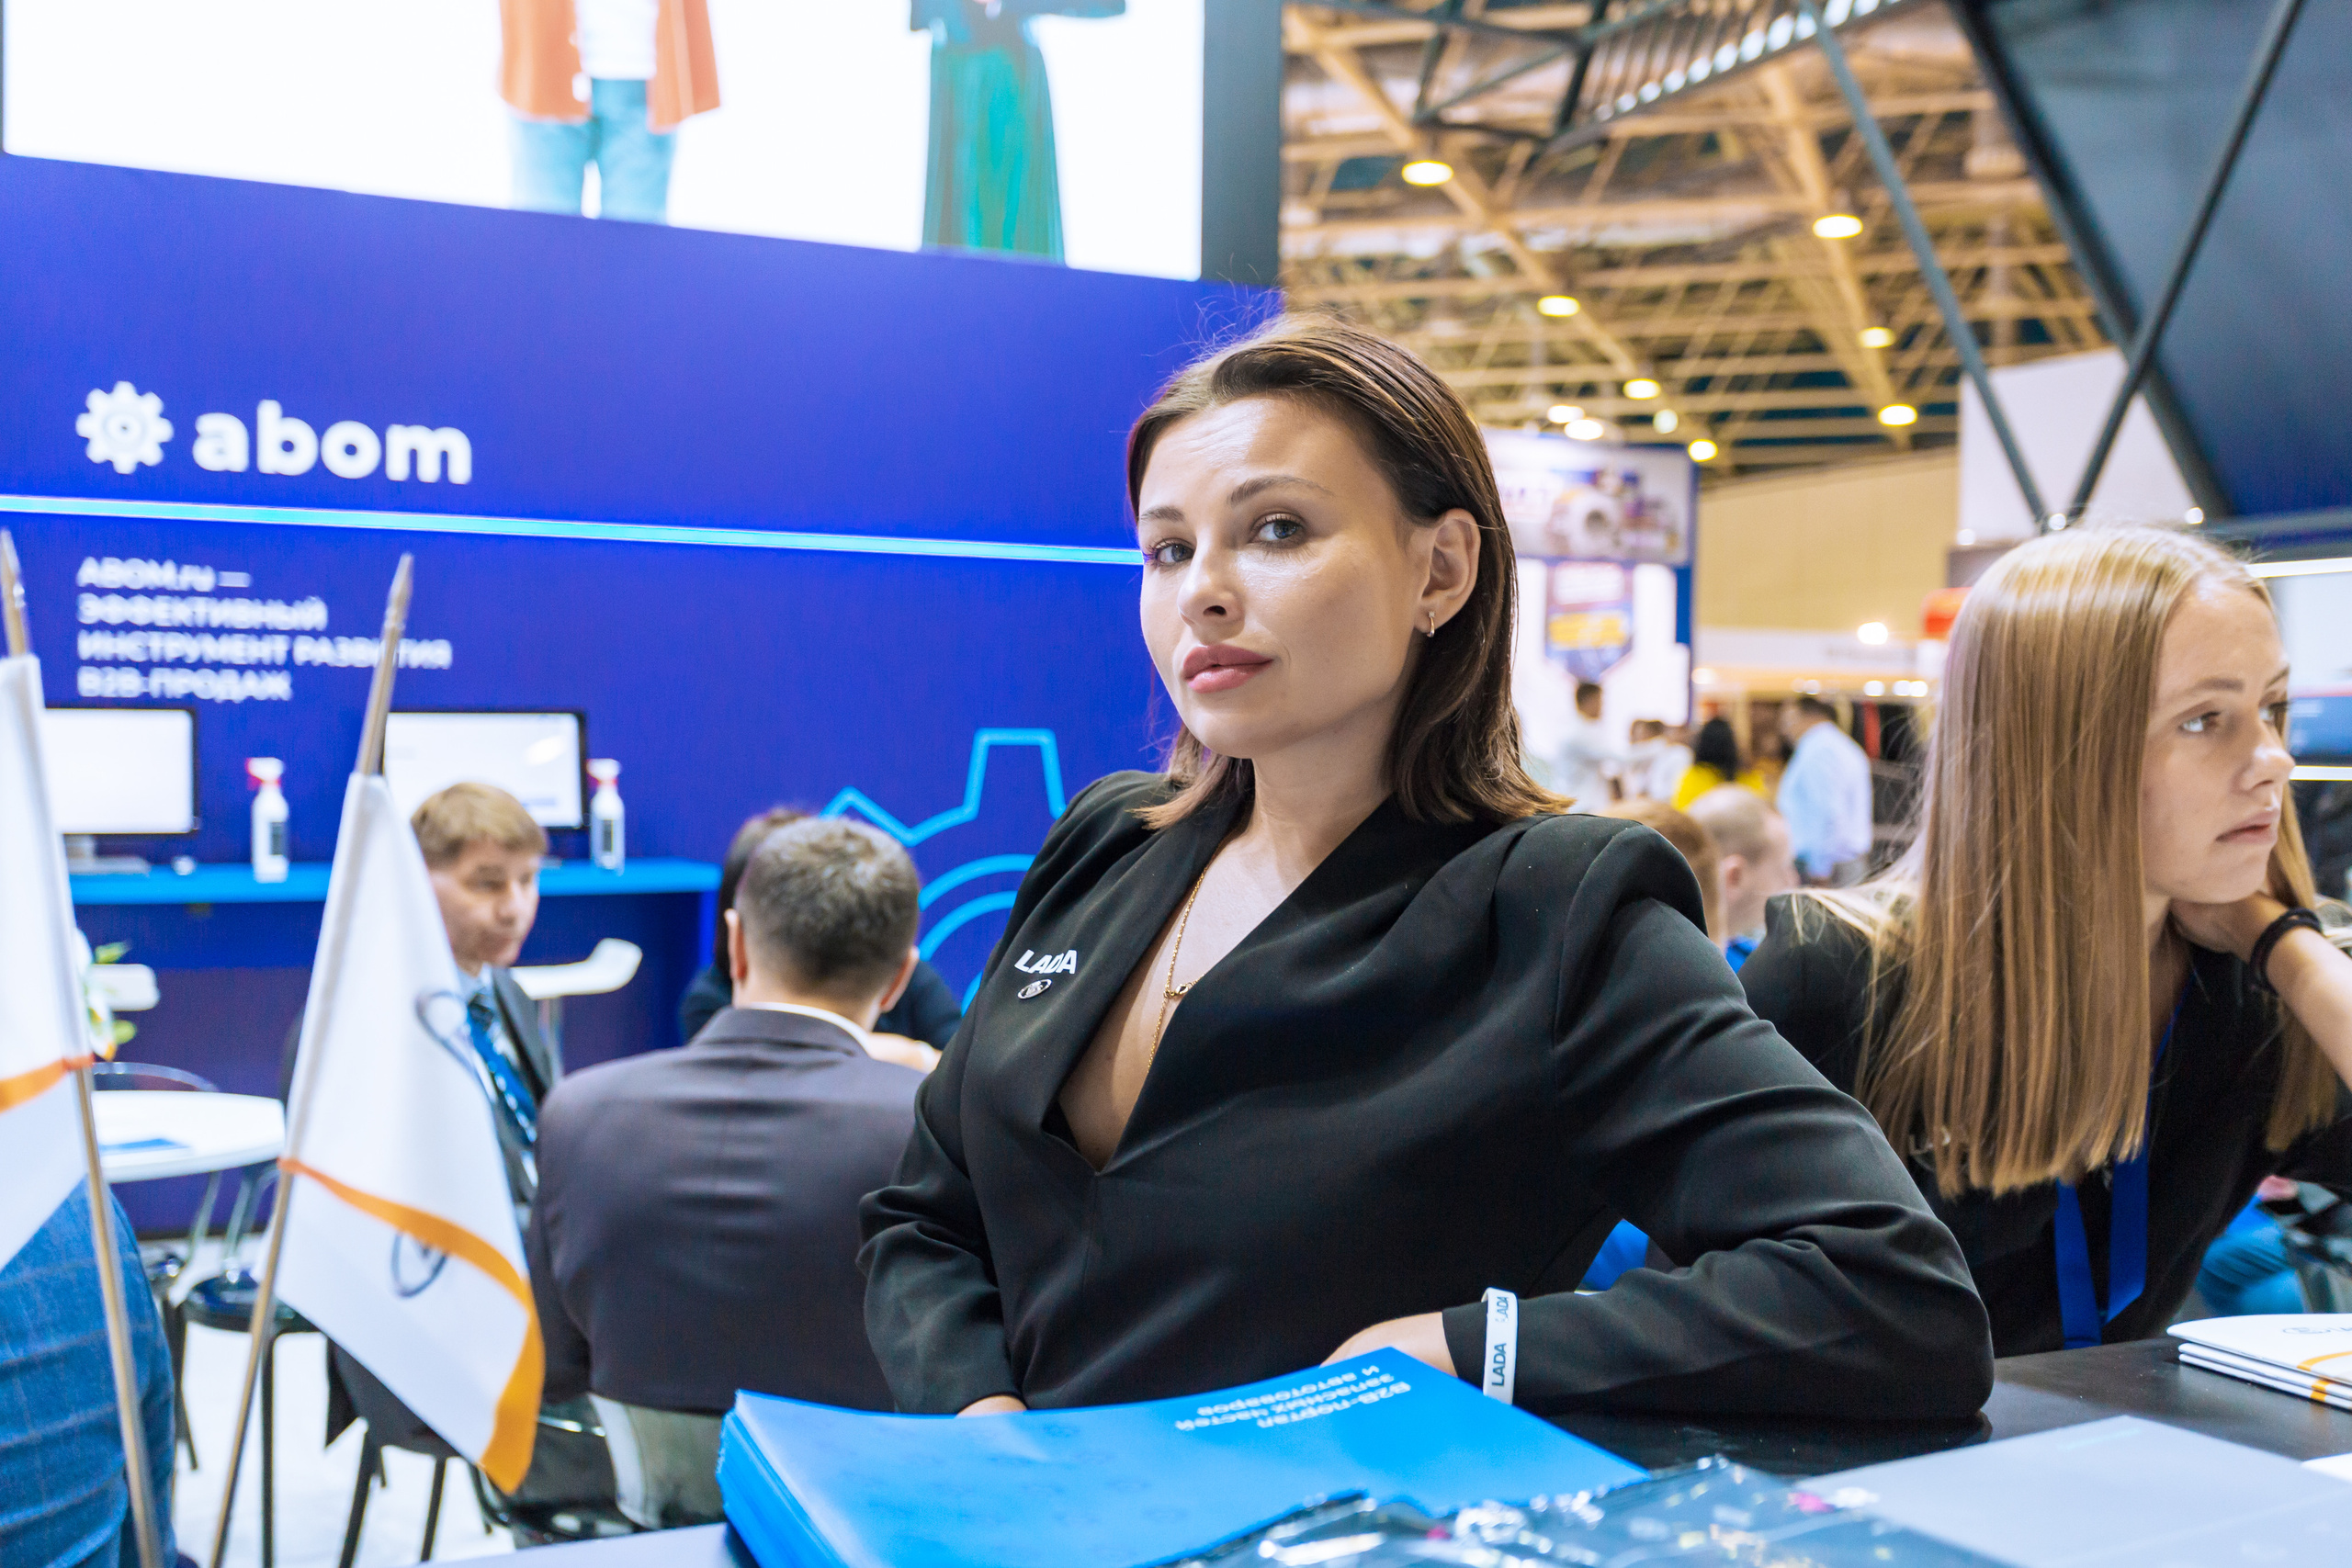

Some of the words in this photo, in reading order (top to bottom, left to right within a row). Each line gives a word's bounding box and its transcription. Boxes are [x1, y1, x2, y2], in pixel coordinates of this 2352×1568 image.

[192, 399, 473, 485] abom
[76, 556, 217, 592] ABOM.ru
[76, 592, 329, 632] ЭФФЕКТИВНЫЙ
[77, 628, 291, 666] ИНСТРУМЕНТ
[1013, 949, 1078, 975] LADA
[1491, 1342, 1508, 1387] LADA
[1196, 1371, 1358, 1417] автотоваров
[1270, 1372, 1396, 1415] запасных
[1174, 1408, 1270, 1432] частей
